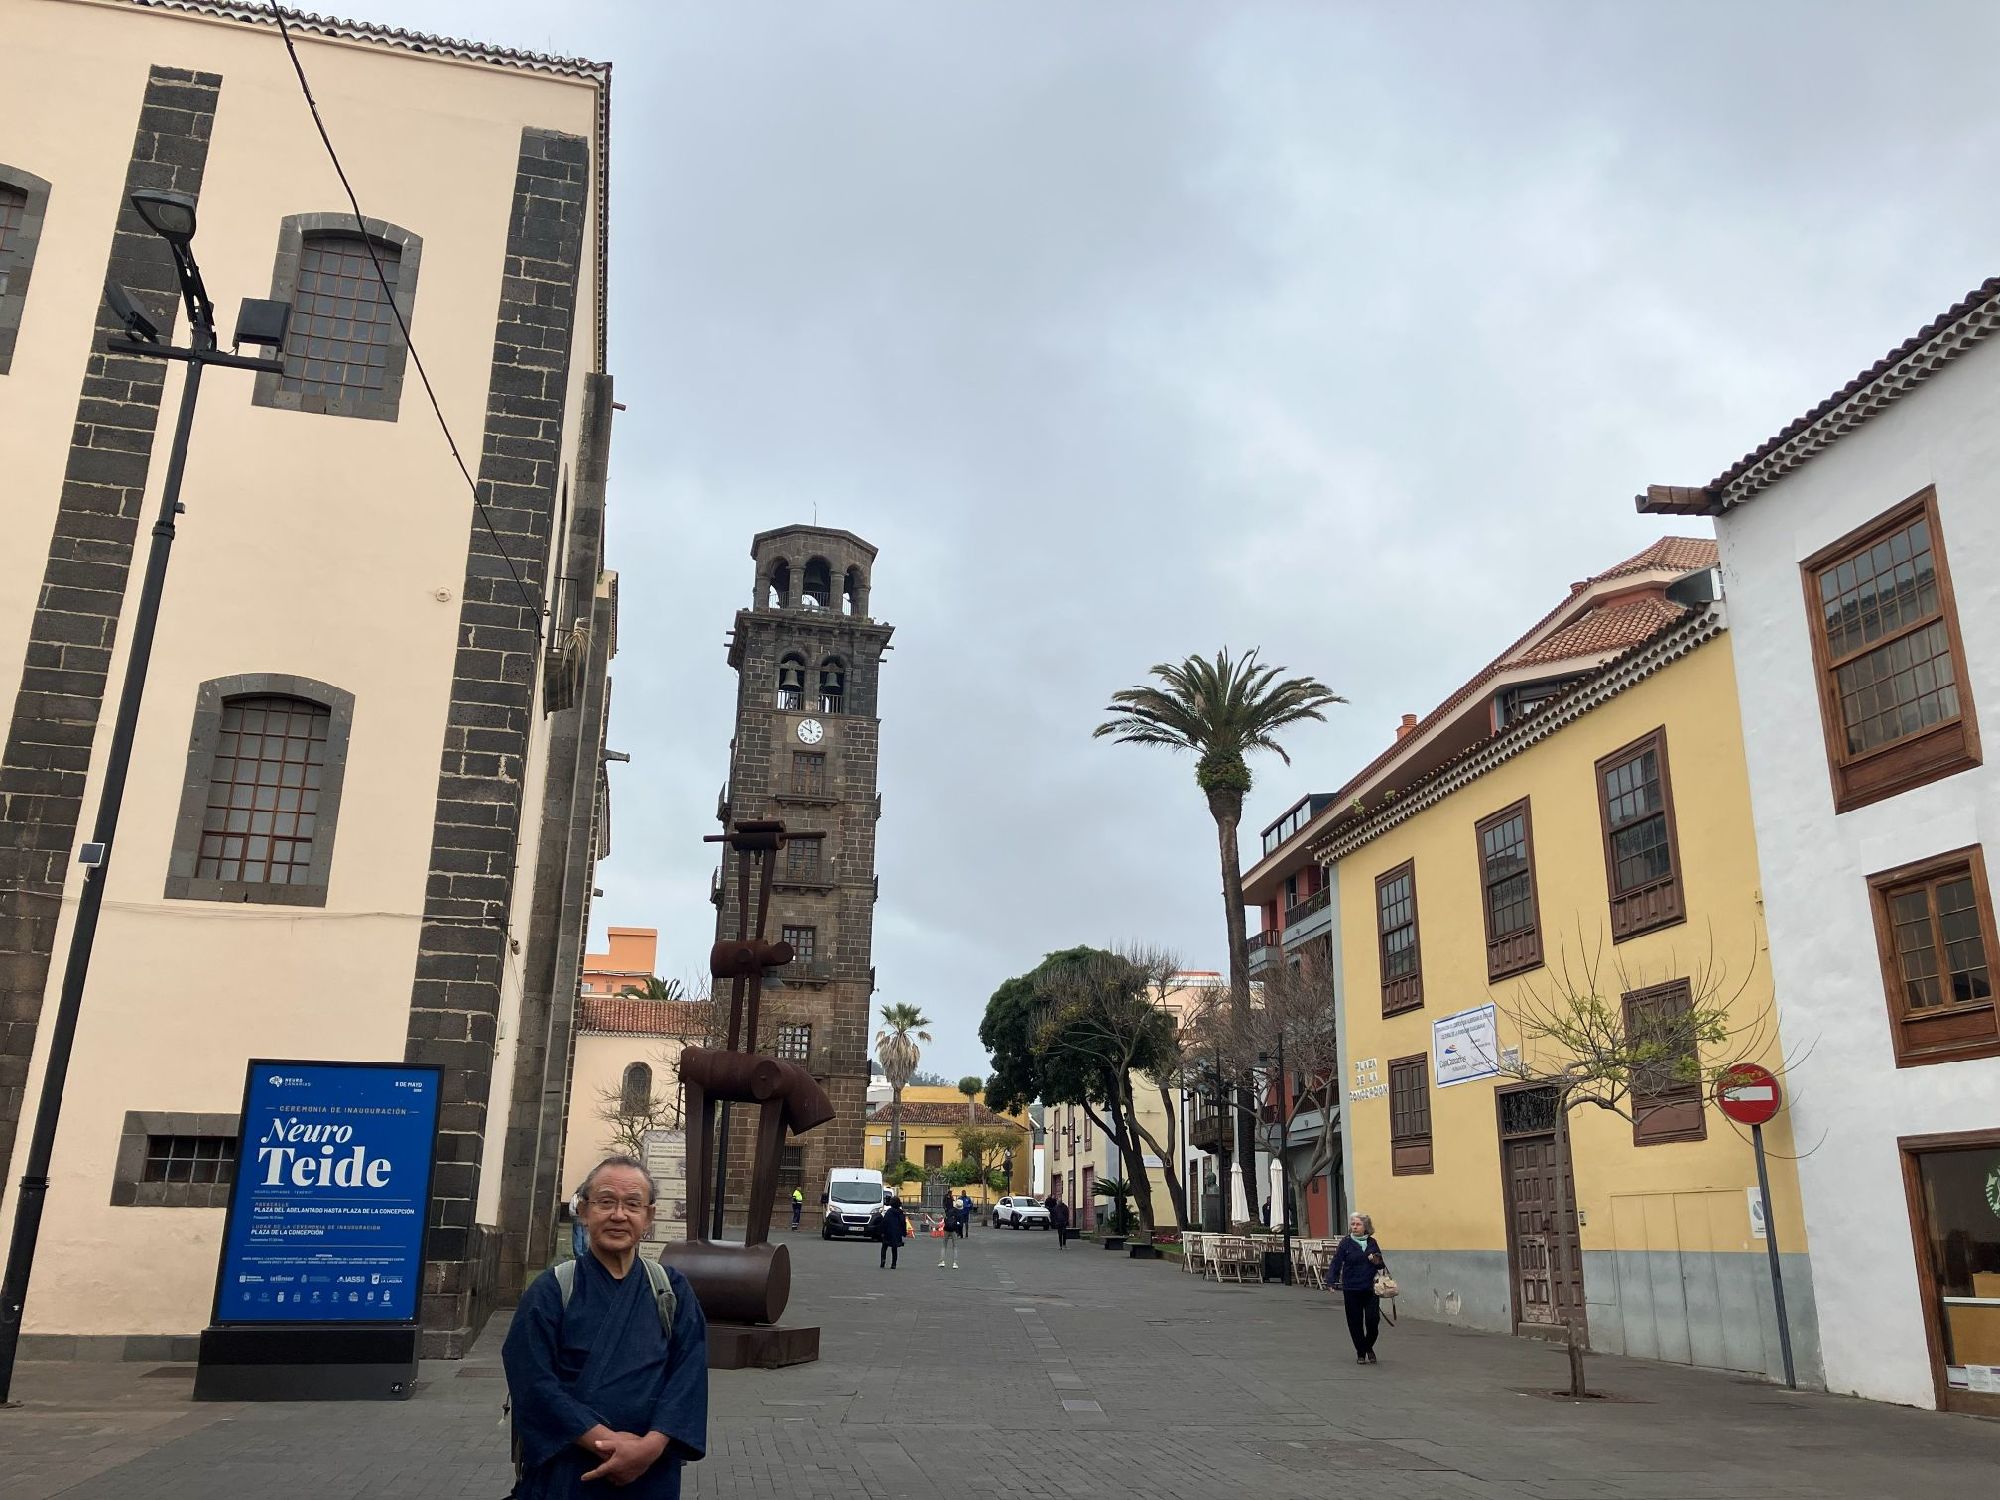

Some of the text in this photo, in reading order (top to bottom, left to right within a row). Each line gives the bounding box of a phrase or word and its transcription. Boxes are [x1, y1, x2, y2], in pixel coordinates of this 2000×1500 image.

[1355, 1059, 1377, 1071] PLAZA
[279, 1105, 326, 1113] CEREMONIA
[260, 1117, 352, 1144] Neuro
[258, 1145, 392, 1188] Teide
